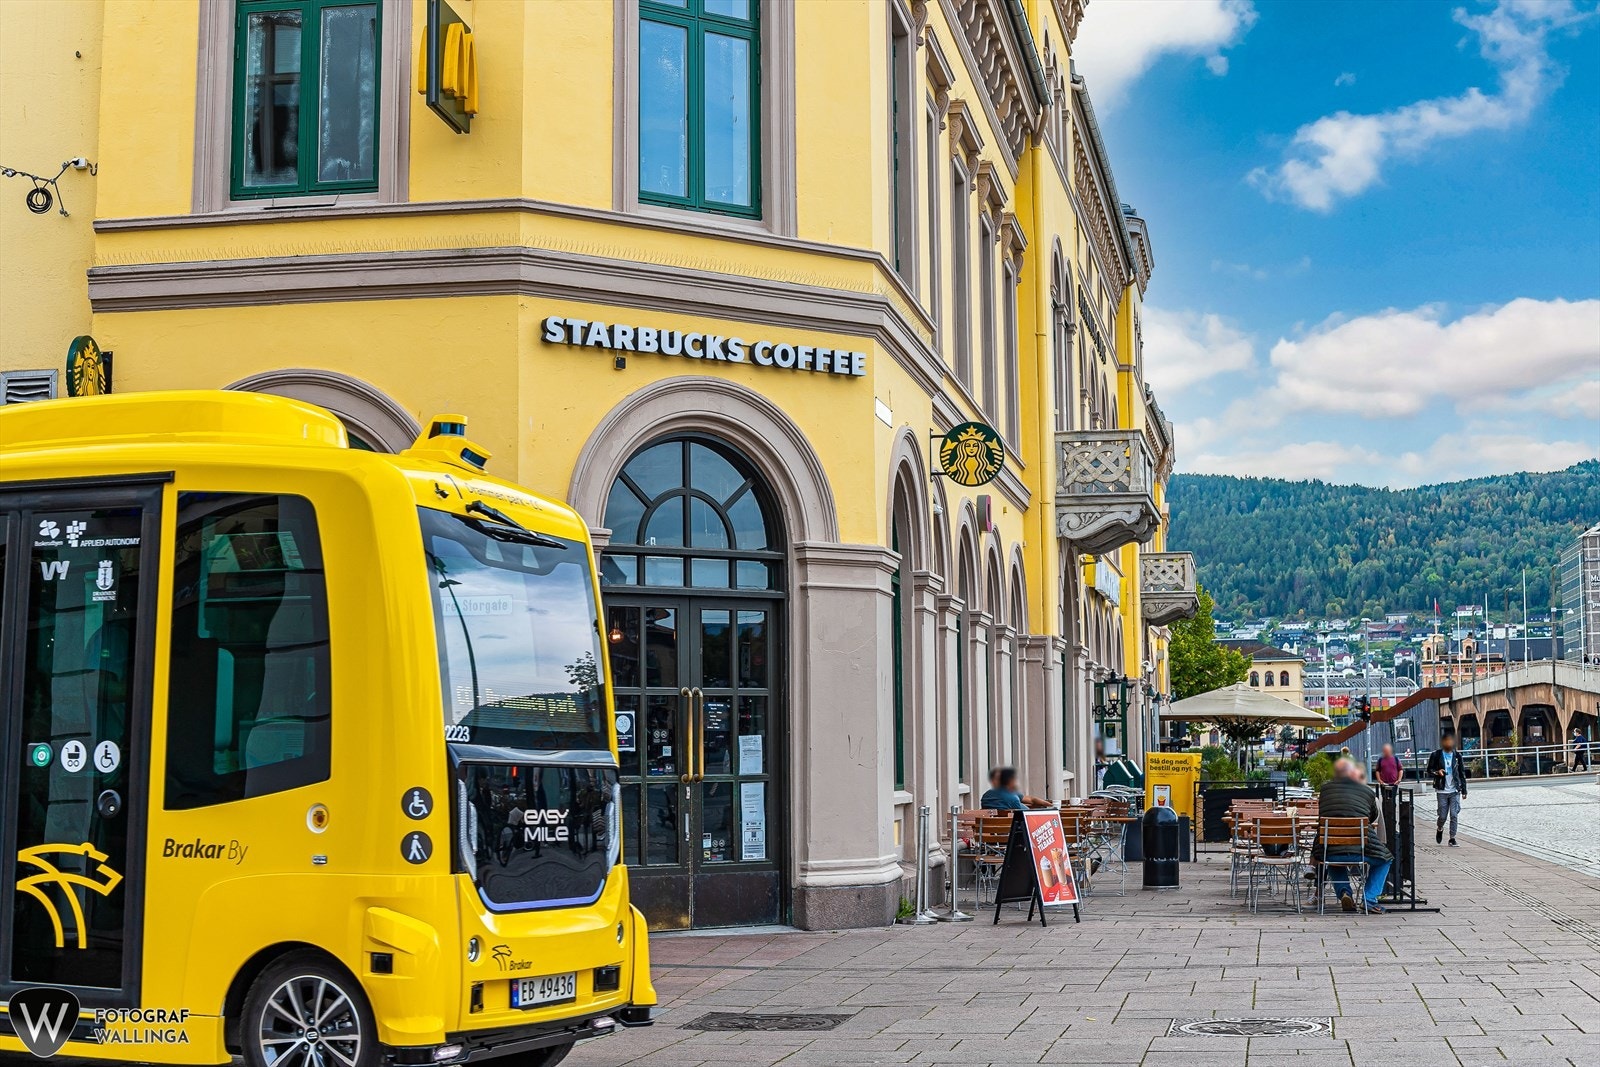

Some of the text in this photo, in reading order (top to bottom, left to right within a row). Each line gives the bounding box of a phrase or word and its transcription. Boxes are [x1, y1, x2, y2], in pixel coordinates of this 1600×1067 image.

[541, 315, 867, 376] STARBUCKS COFFEE
[80, 537, 141, 547] APPLIED AUTONOMY
[462, 599, 508, 614] Storgate
[445, 725, 470, 742] 2223
[1161, 758, 1174, 766] deg
[163, 838, 248, 865] Brakar By
[509, 959, 533, 971] Brakar
[521, 980, 535, 1002] EB
[539, 975, 573, 998] 49436
